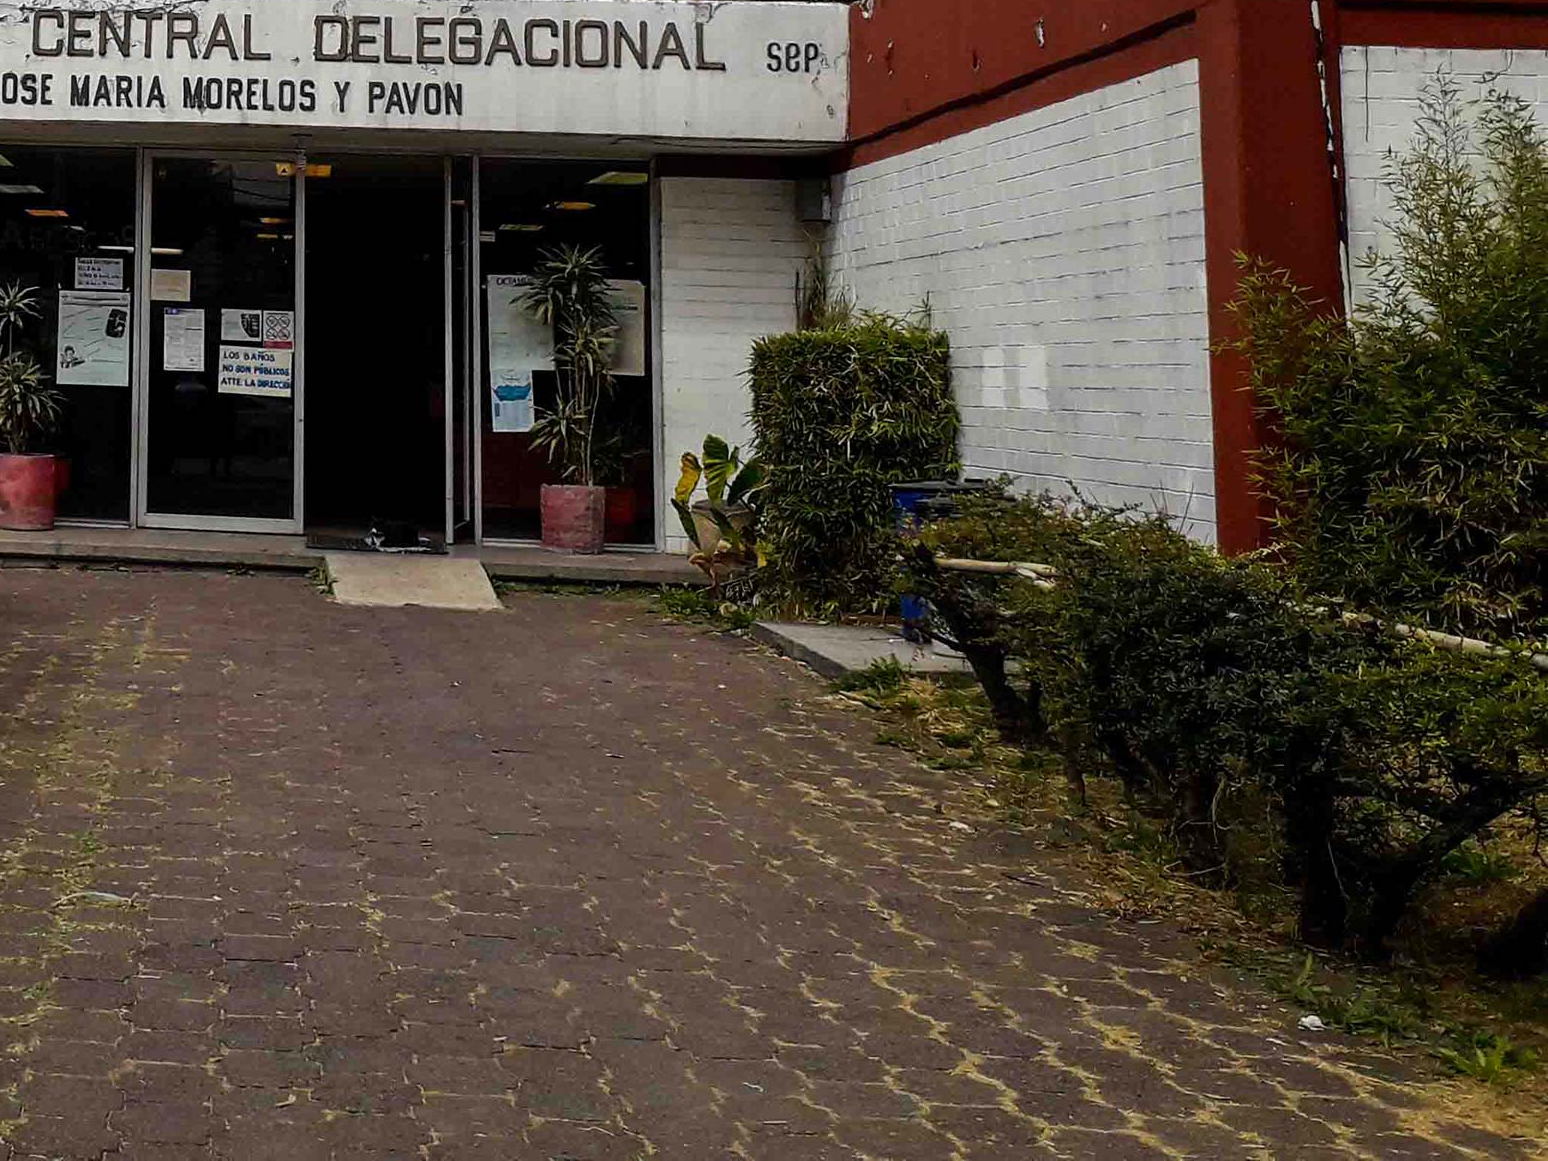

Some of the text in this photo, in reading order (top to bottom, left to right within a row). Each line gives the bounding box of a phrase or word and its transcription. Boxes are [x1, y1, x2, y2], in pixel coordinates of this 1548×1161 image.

[31, 9, 272, 61] CENTRAL
[313, 14, 727, 71] DELEGACIONAL
[69, 73, 166, 109] MARIA
[181, 76, 316, 113] MORELOS
[332, 80, 352, 114] Y
[367, 80, 464, 117] PAVON
[223, 350, 240, 360] LOS
[222, 363, 234, 373] NO
[234, 364, 252, 374] SON
[244, 378, 256, 387] LA
